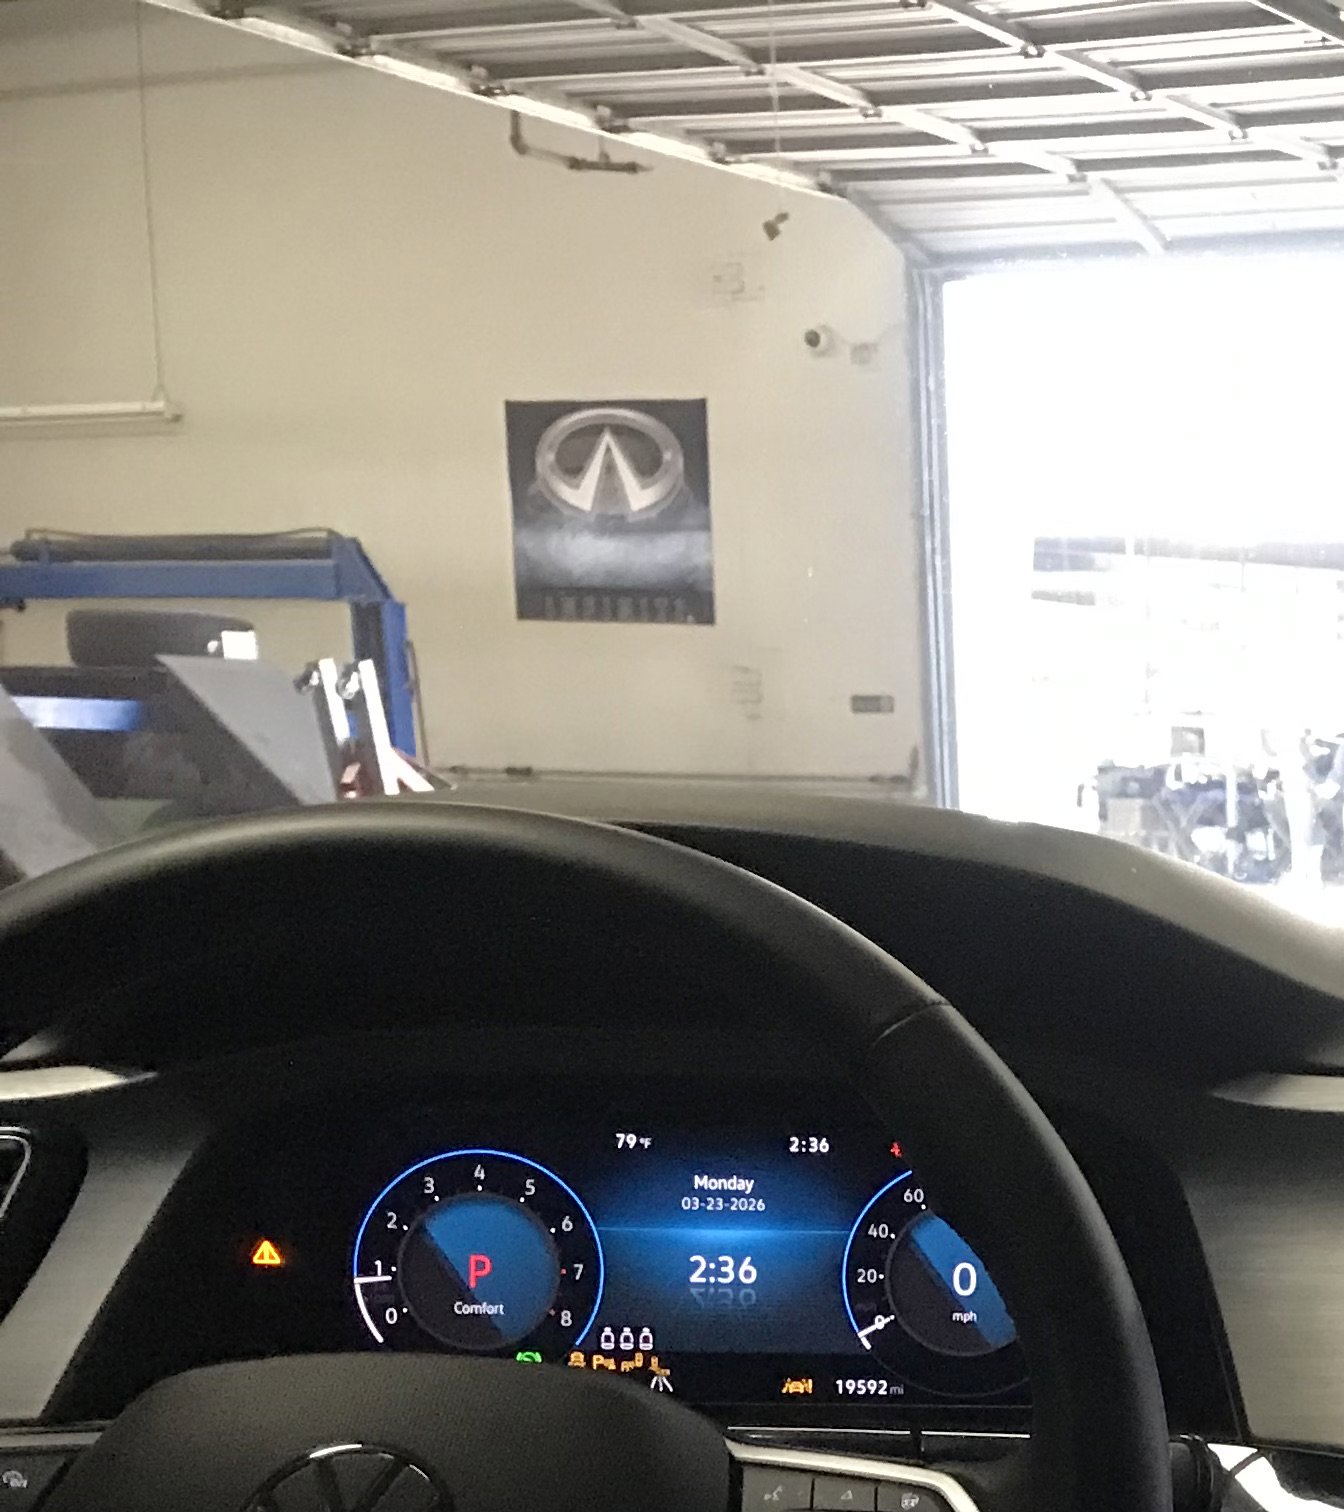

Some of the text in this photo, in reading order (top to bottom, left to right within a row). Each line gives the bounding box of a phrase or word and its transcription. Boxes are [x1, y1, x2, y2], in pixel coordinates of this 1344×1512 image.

[788, 1136, 830, 1153] 2:36
[474, 1164, 485, 1180] 4
[423, 1176, 435, 1194] 3
[525, 1179, 536, 1195] 5
[693, 1175, 755, 1194] Monday
[681, 1196, 766, 1212] 03-23-2026
[903, 1188, 924, 1203] 60
[386, 1212, 398, 1230] 2
[561, 1216, 573, 1232] 6
[868, 1224, 889, 1239] 40
[374, 1259, 383, 1277] 1
[469, 1253, 492, 1289] P
[573, 1263, 584, 1280] 7
[688, 1255, 758, 1284] 2:36
[857, 1268, 877, 1283] 20
[952, 1262, 977, 1297] 0
[385, 1307, 398, 1325] 0
[453, 1301, 505, 1316] Comfort
[560, 1310, 572, 1327] 8
[952, 1311, 978, 1324] mph
[836, 1379, 888, 1396] 19592
